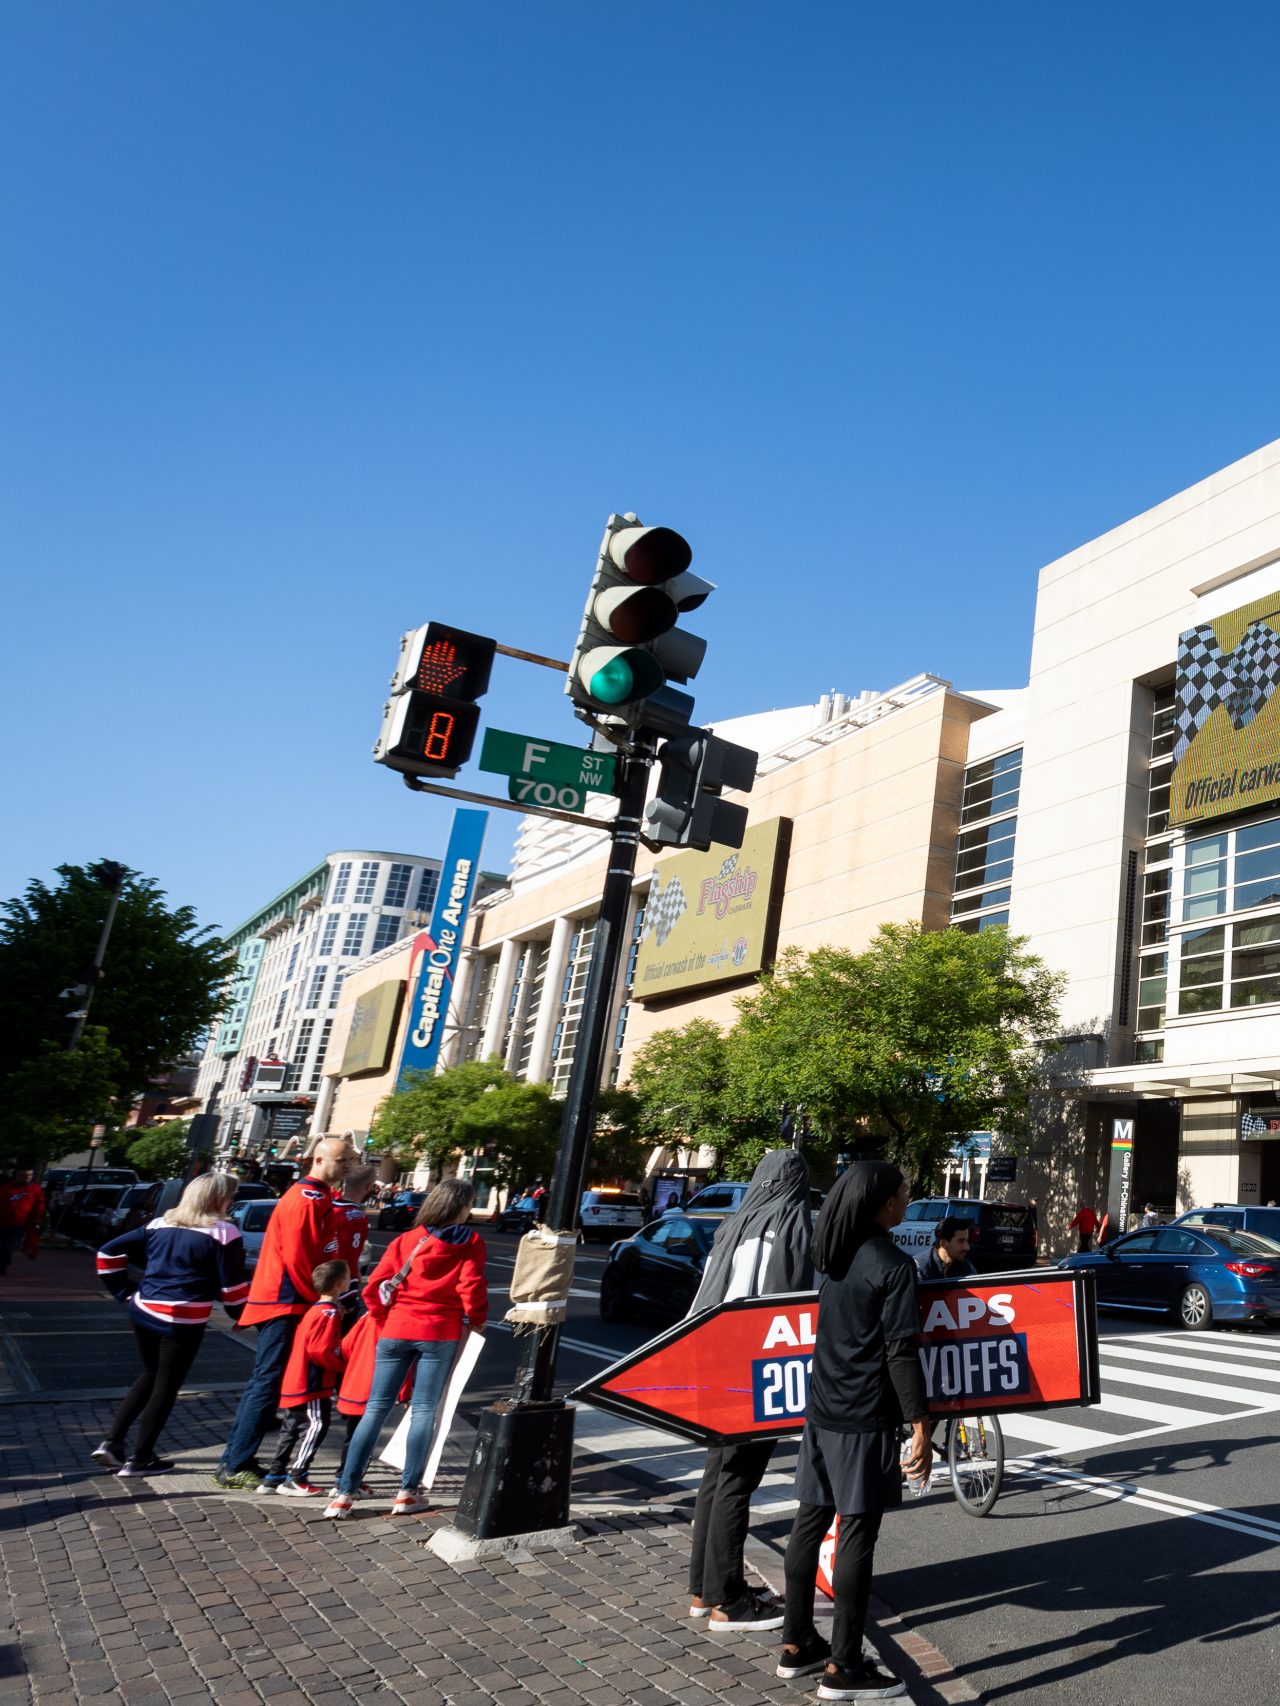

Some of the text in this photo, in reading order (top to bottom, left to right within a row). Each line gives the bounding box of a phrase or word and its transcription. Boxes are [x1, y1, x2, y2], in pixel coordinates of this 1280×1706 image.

[424, 711, 455, 760] 8
[522, 742, 550, 773] F
[582, 755, 604, 771] ST
[516, 777, 580, 809] 700
[579, 771, 604, 787] NW
[1185, 769, 1237, 809] Official
[441, 858, 473, 926] Arena
[696, 866, 758, 920] Flagship
[1114, 1121, 1133, 1139] M
[1121, 1151, 1131, 1179] Gallery
[352, 1233, 361, 1248] 8
[894, 1234, 932, 1247] POLICE
